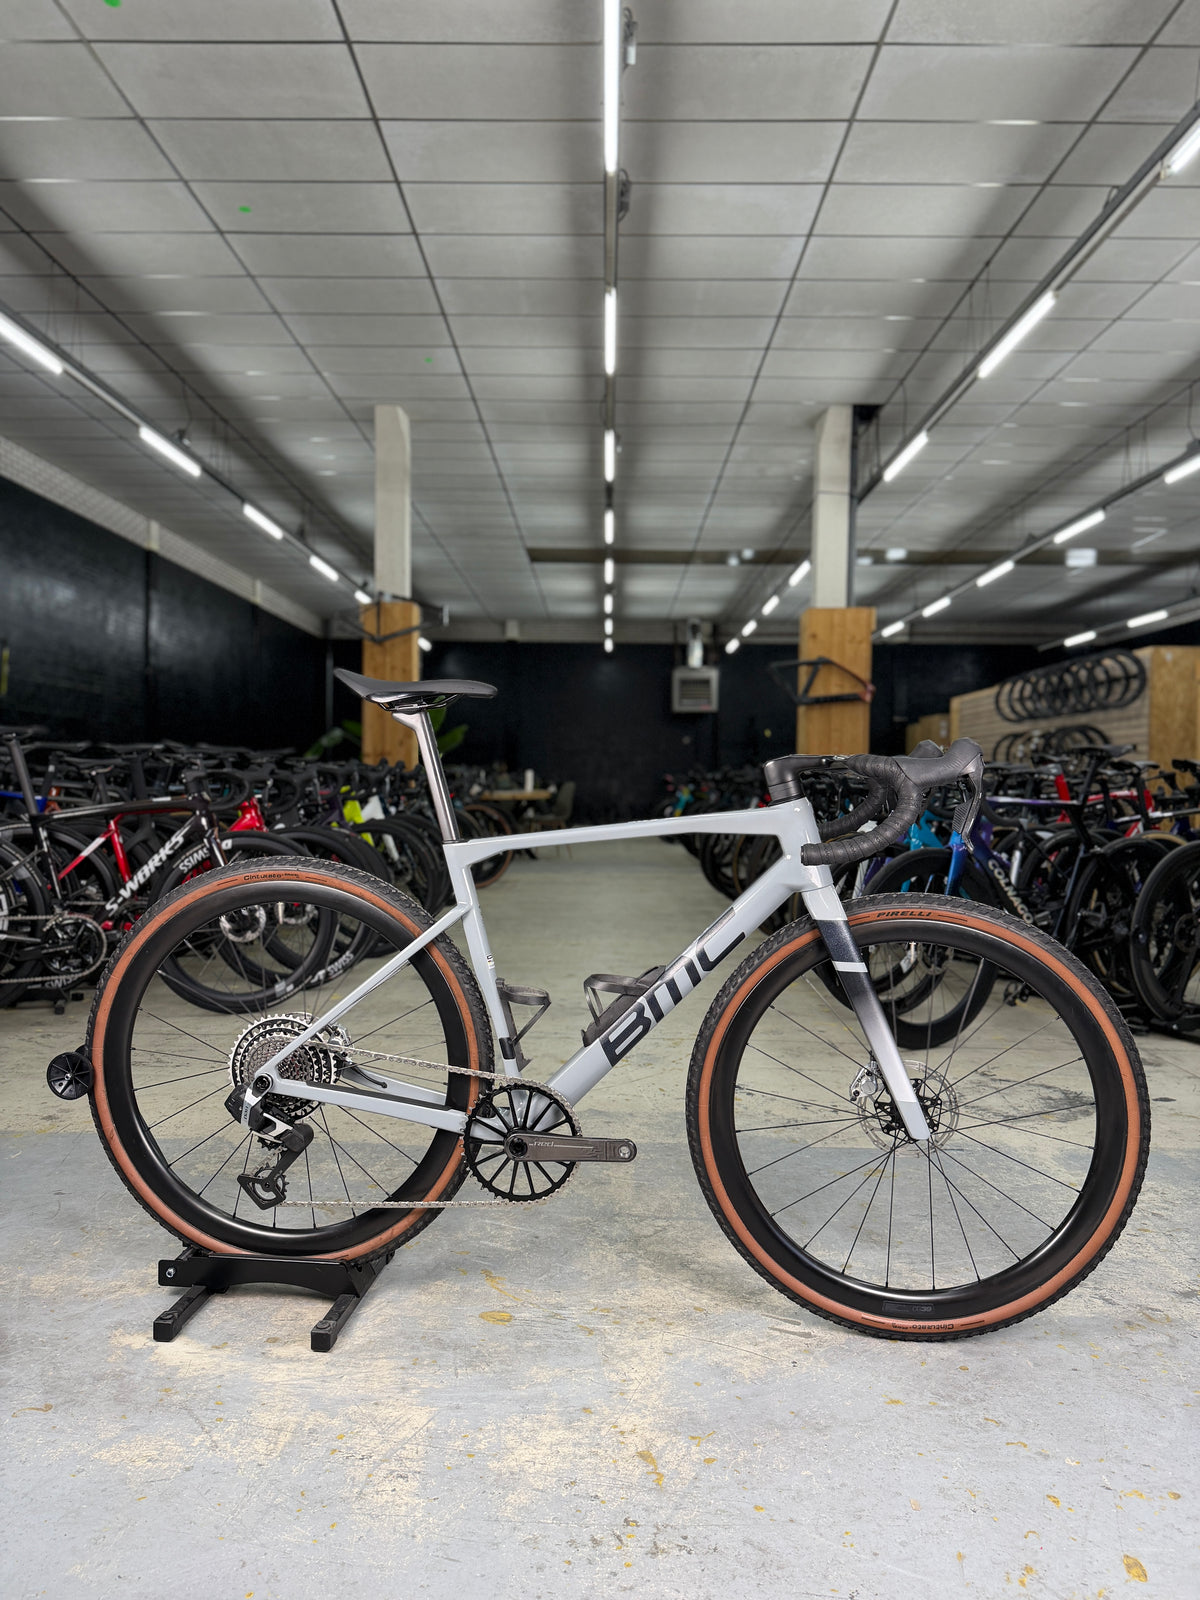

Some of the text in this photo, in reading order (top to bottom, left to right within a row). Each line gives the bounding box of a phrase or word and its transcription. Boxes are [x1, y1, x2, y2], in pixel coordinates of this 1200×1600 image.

[105, 825, 191, 917] S-WORKS
[988, 859, 1034, 924] COLNAGO
[876, 910, 932, 918] PIRELLI
